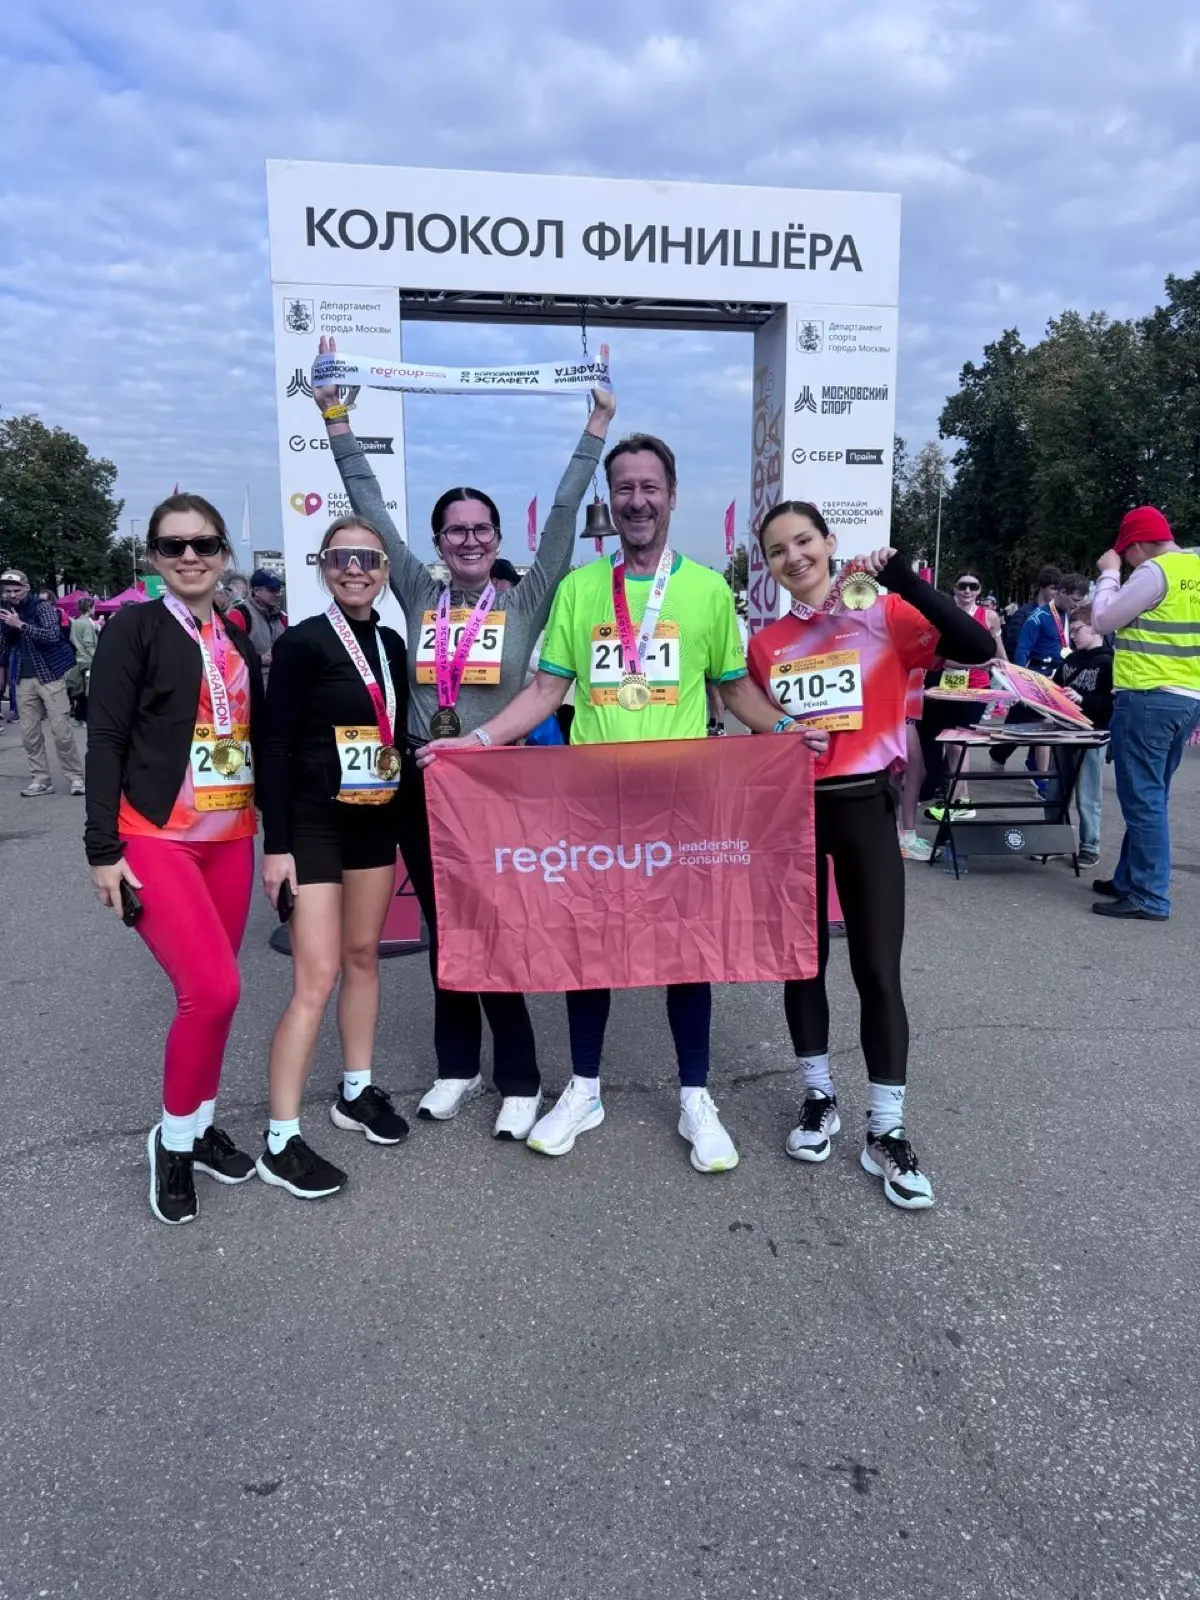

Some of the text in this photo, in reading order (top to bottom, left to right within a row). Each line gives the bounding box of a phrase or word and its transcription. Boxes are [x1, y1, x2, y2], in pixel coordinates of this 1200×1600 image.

[305, 206, 864, 273] КОЛОКОЛ ФИНИШЁРА
[320, 300, 382, 312] Департамент
[320, 313, 353, 323] спорта
[320, 324, 392, 334] города Москвы
[828, 322, 883, 333] Департамент
[828, 333, 857, 342] спорта
[828, 344, 891, 354] города Москвы
[370, 366, 425, 379] regroup
[474, 377, 540, 385] ЭСТАФЕТА
[821, 384, 888, 401] МОСКОВСКИЙ
[821, 401, 853, 415] СПОРТ
[309, 439, 330, 451] СБ
[809, 451, 877, 463] СБЕР Прайм
[822, 507, 884, 517] МОСКОВСКИЙ
[595, 643, 671, 670] 21-1
[944, 675, 966, 686] 5428
[776, 669, 856, 705] 210-3
[494, 838, 750, 884] regroup leadership
[679, 850, 752, 866] consulting
